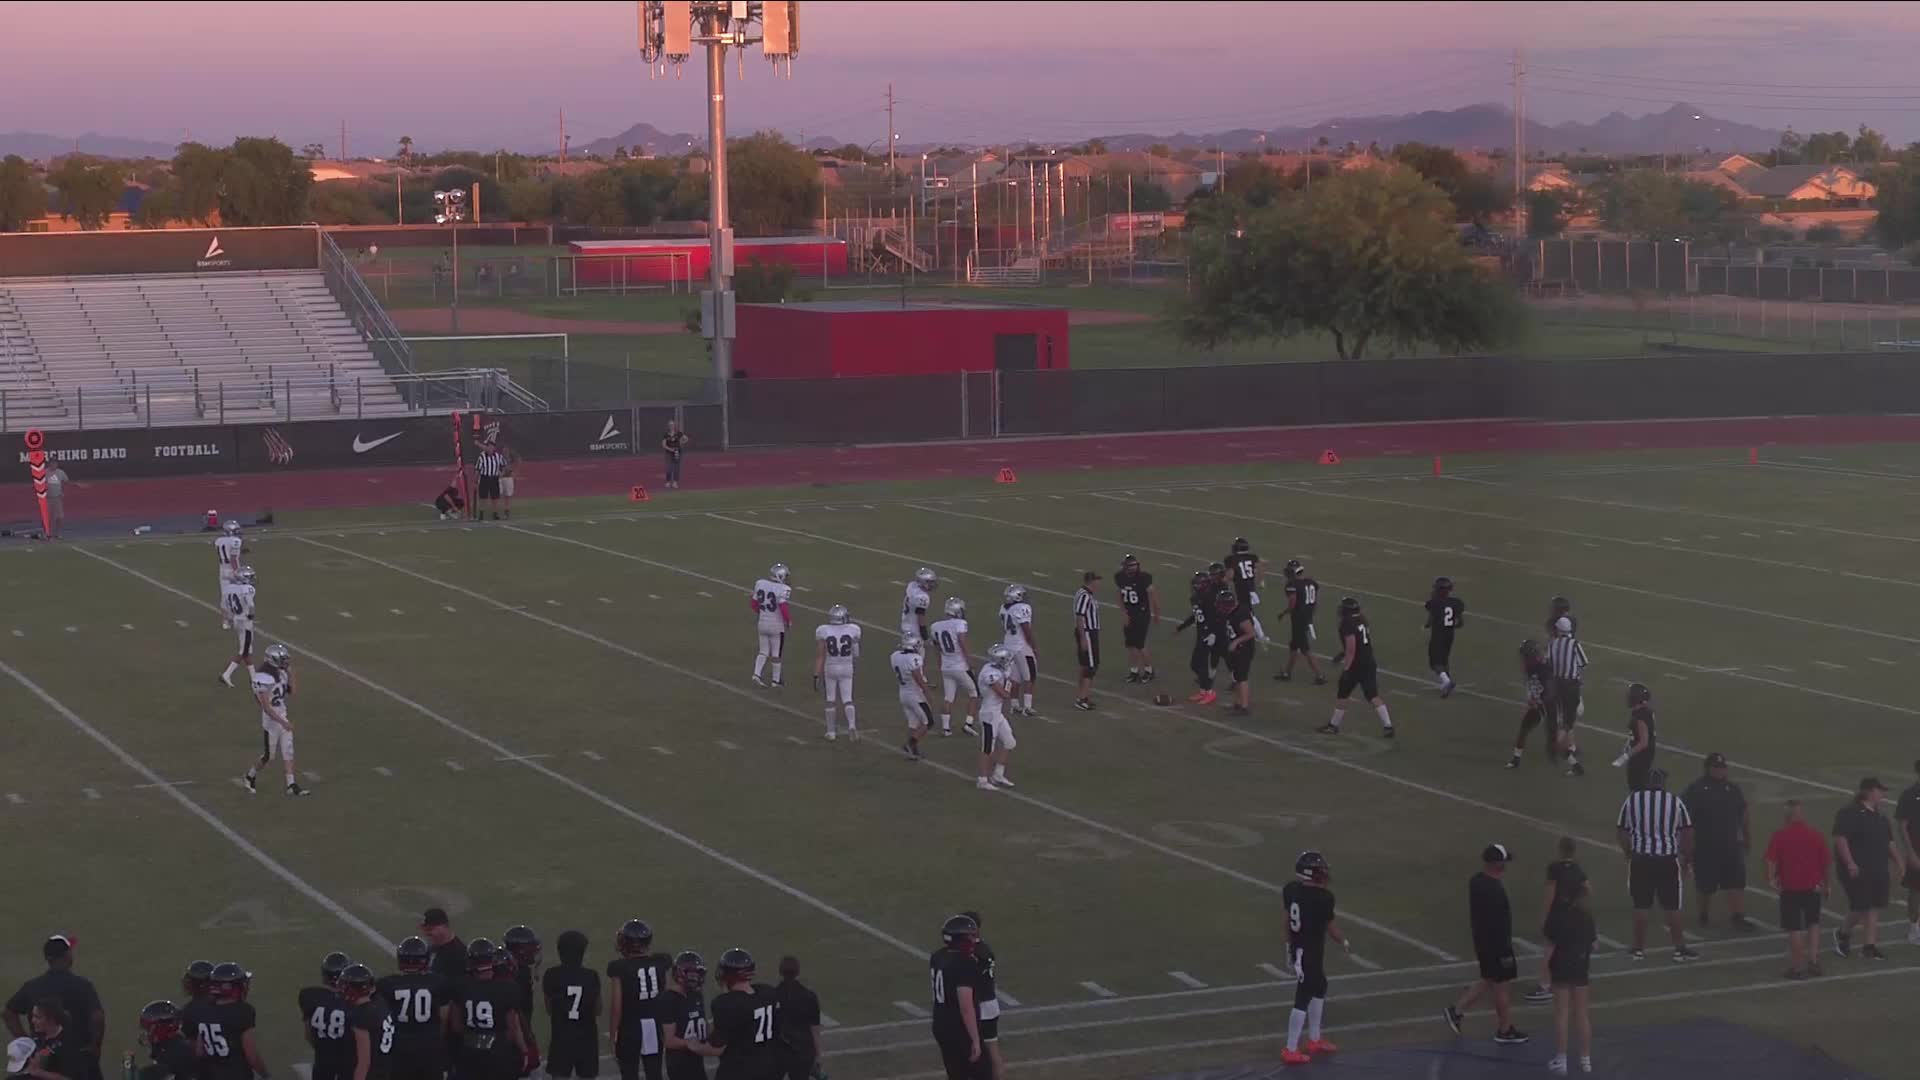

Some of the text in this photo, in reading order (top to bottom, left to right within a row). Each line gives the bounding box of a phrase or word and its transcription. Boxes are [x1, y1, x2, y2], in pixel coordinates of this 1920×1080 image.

[19, 446, 127, 464] MRCHING BAND
[154, 444, 220, 458] FOOTBALL
[635, 487, 646, 499] 20
[1238, 560, 1255, 580] 15
[227, 593, 243, 616] 13
[756, 589, 778, 613] 23
[1120, 588, 1139, 604] 76
[1304, 584, 1316, 605] 10
[1444, 606, 1454, 627] 2
[826, 634, 852, 657] 82
[934, 629, 956, 654] 10
[1281, 901, 1288, 933] 9
[637, 966, 660, 1000] 11
[394, 988, 432, 1023] 70
[465, 999, 495, 1029] 19
[566, 985, 583, 1020] 7
[310, 1006, 346, 1040] 48
[684, 1016, 708, 1042] 40
[754, 1004, 773, 1044] 71
